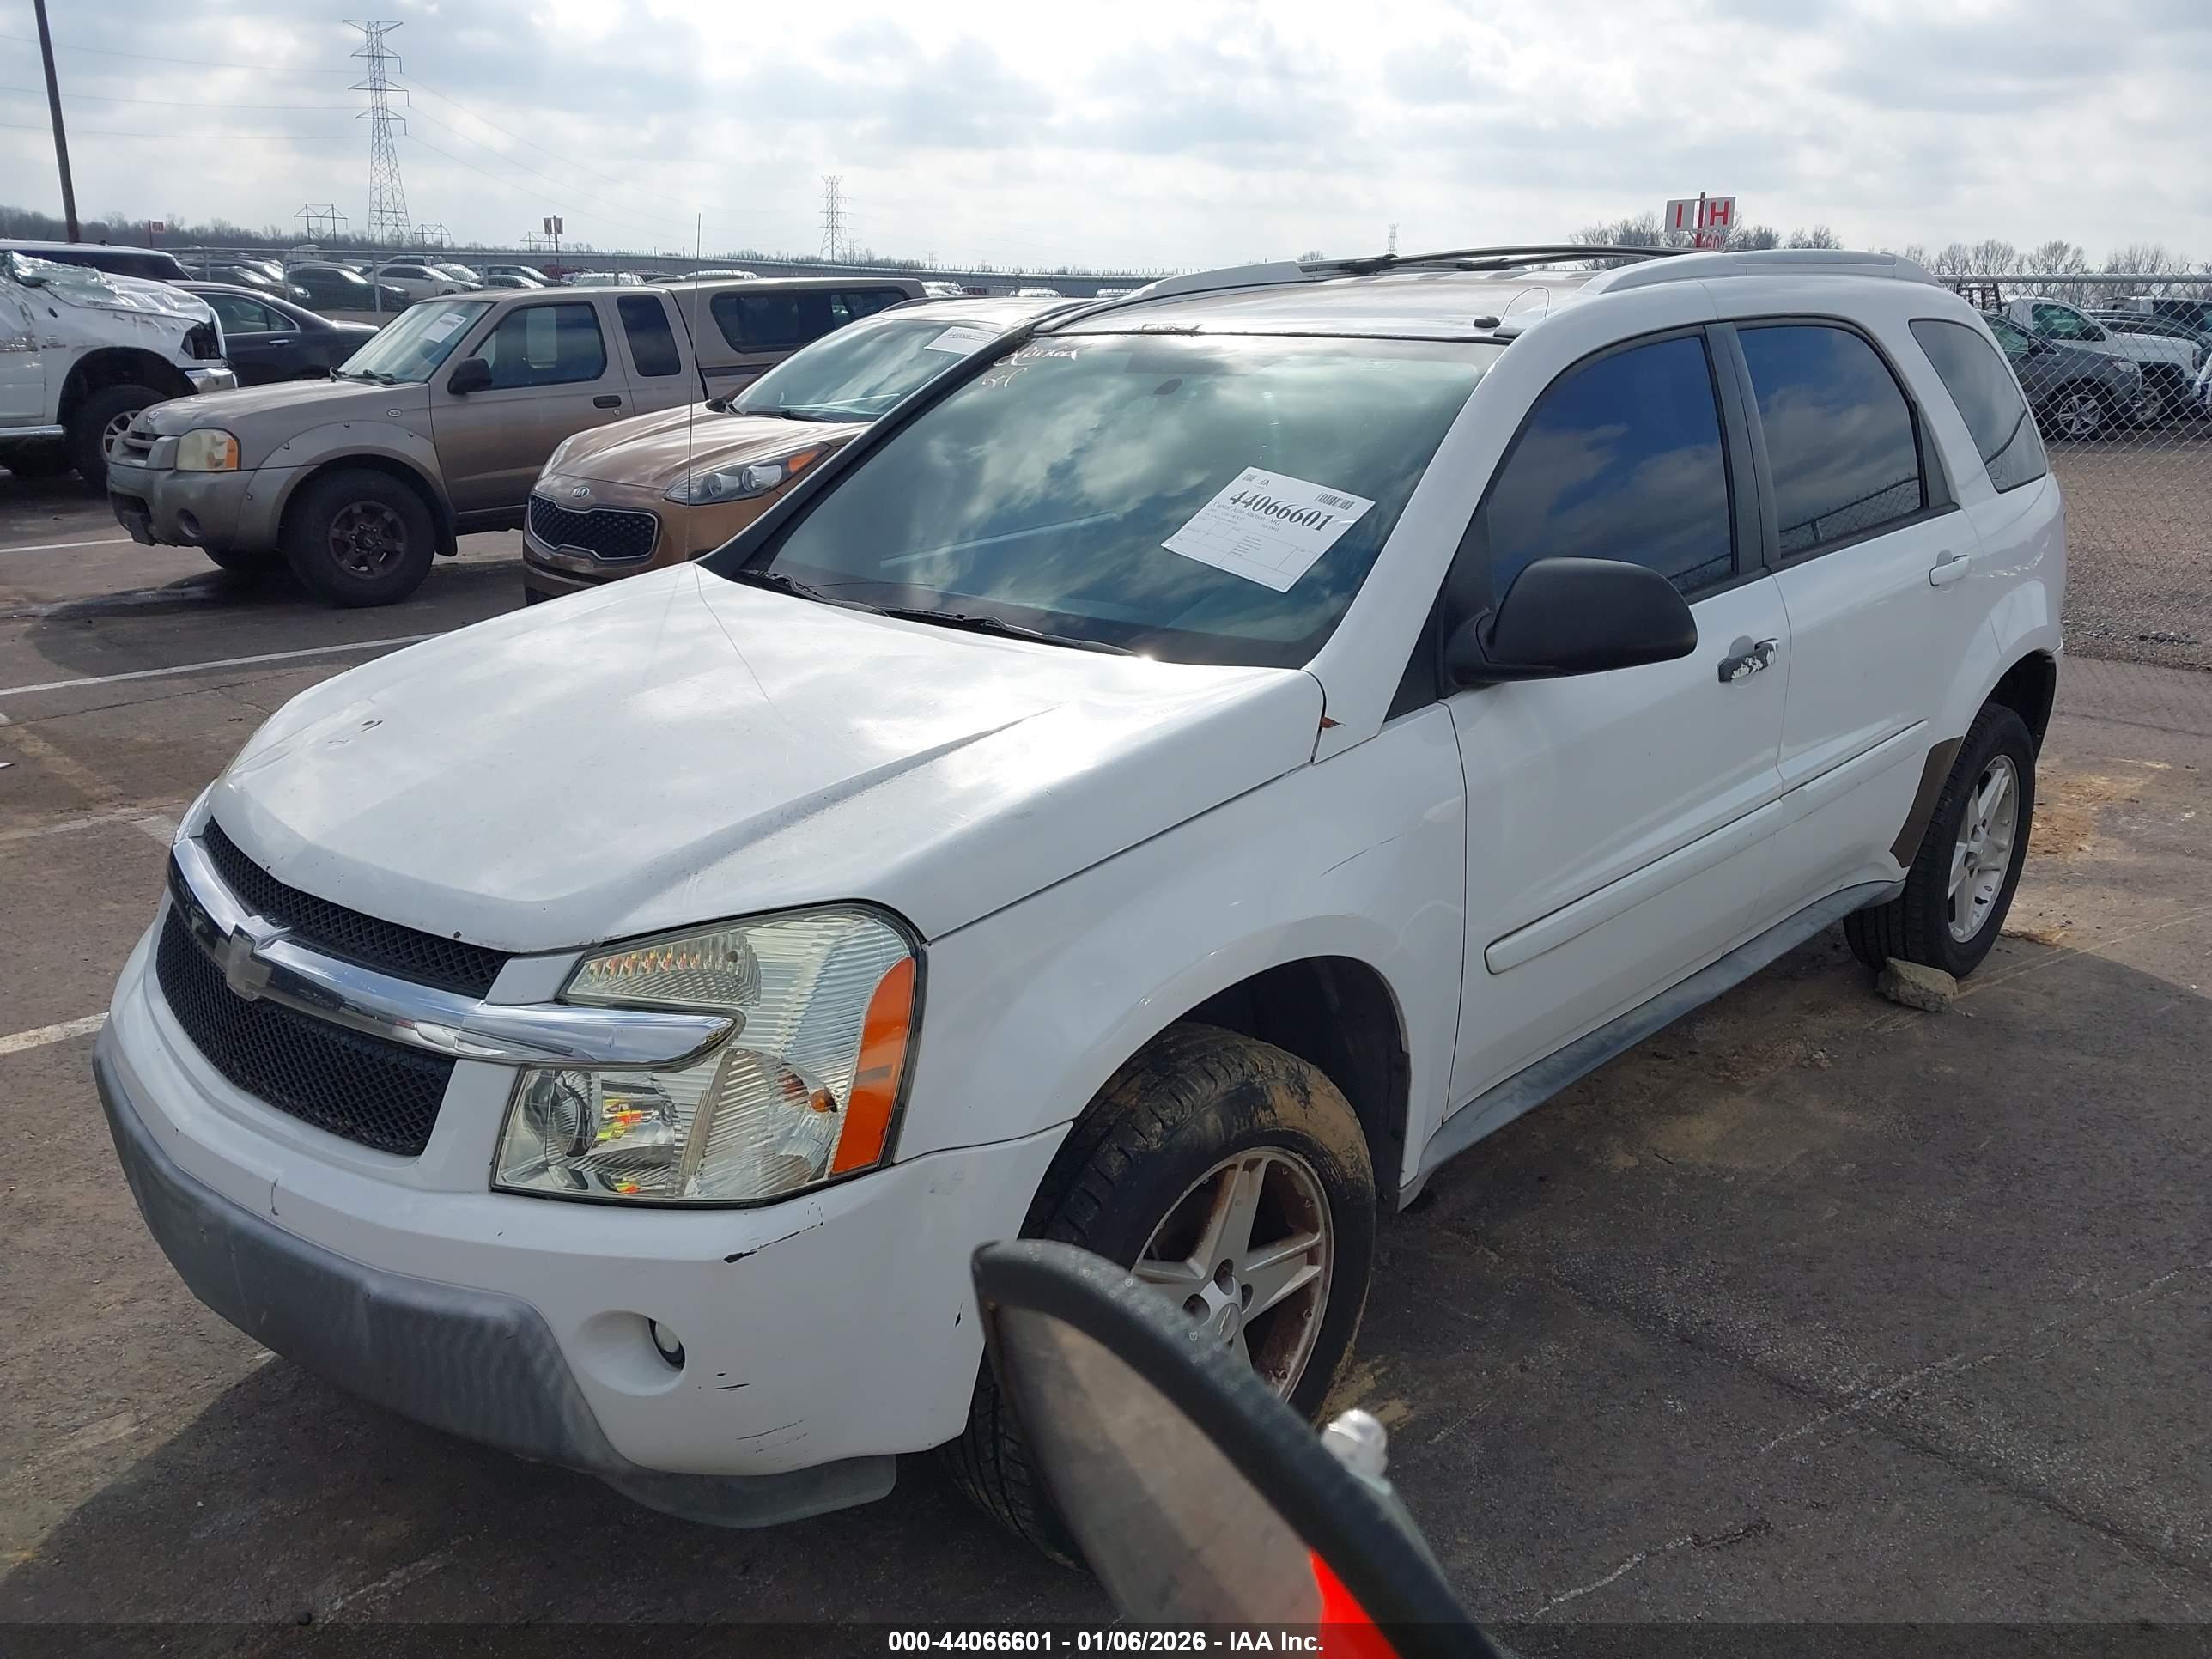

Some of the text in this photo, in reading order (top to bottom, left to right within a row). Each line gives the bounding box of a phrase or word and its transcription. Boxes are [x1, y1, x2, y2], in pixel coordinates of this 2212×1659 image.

[1710, 201, 1729, 226] H
[153, 222, 164, 232] 60
[1230, 490, 1334, 532] 44066601
